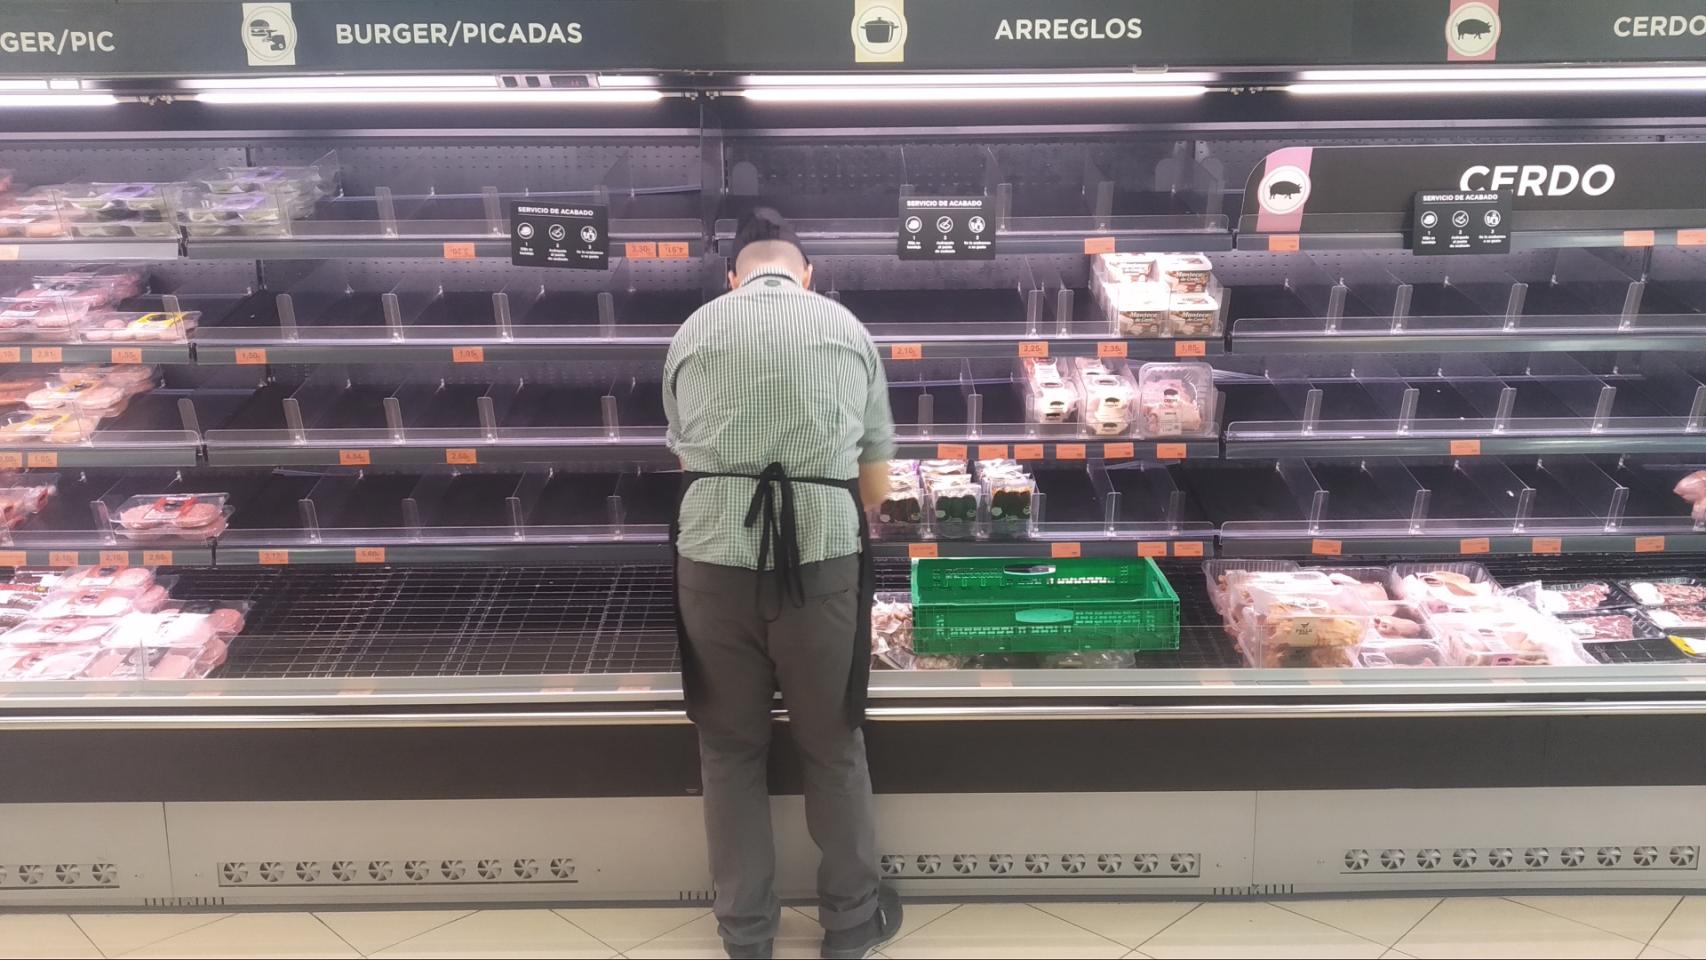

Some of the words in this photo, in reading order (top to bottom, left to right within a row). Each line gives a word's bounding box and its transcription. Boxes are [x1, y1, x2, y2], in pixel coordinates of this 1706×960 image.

[335, 21, 583, 47] BURGER/PICADAS
[994, 18, 1143, 39] ARREGLOS
[1613, 15, 1706, 38] CERDO
[0, 29, 116, 55] GER/PIC
[517, 206, 549, 214] SERVICIO
